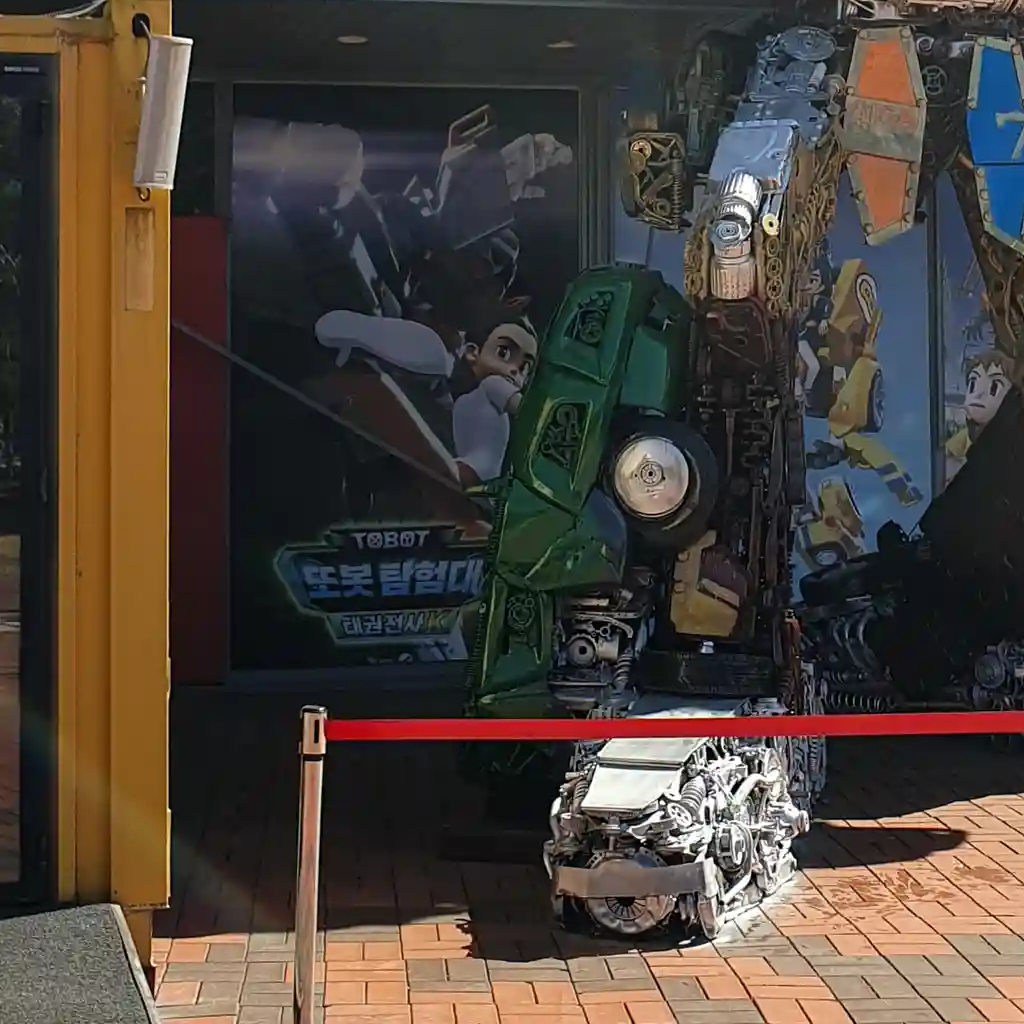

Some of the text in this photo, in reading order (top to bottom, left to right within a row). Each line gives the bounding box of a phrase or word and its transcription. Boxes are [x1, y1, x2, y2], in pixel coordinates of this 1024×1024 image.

[352, 530, 430, 550] TOBOT
[302, 557, 485, 598] 또봇 탐험대
